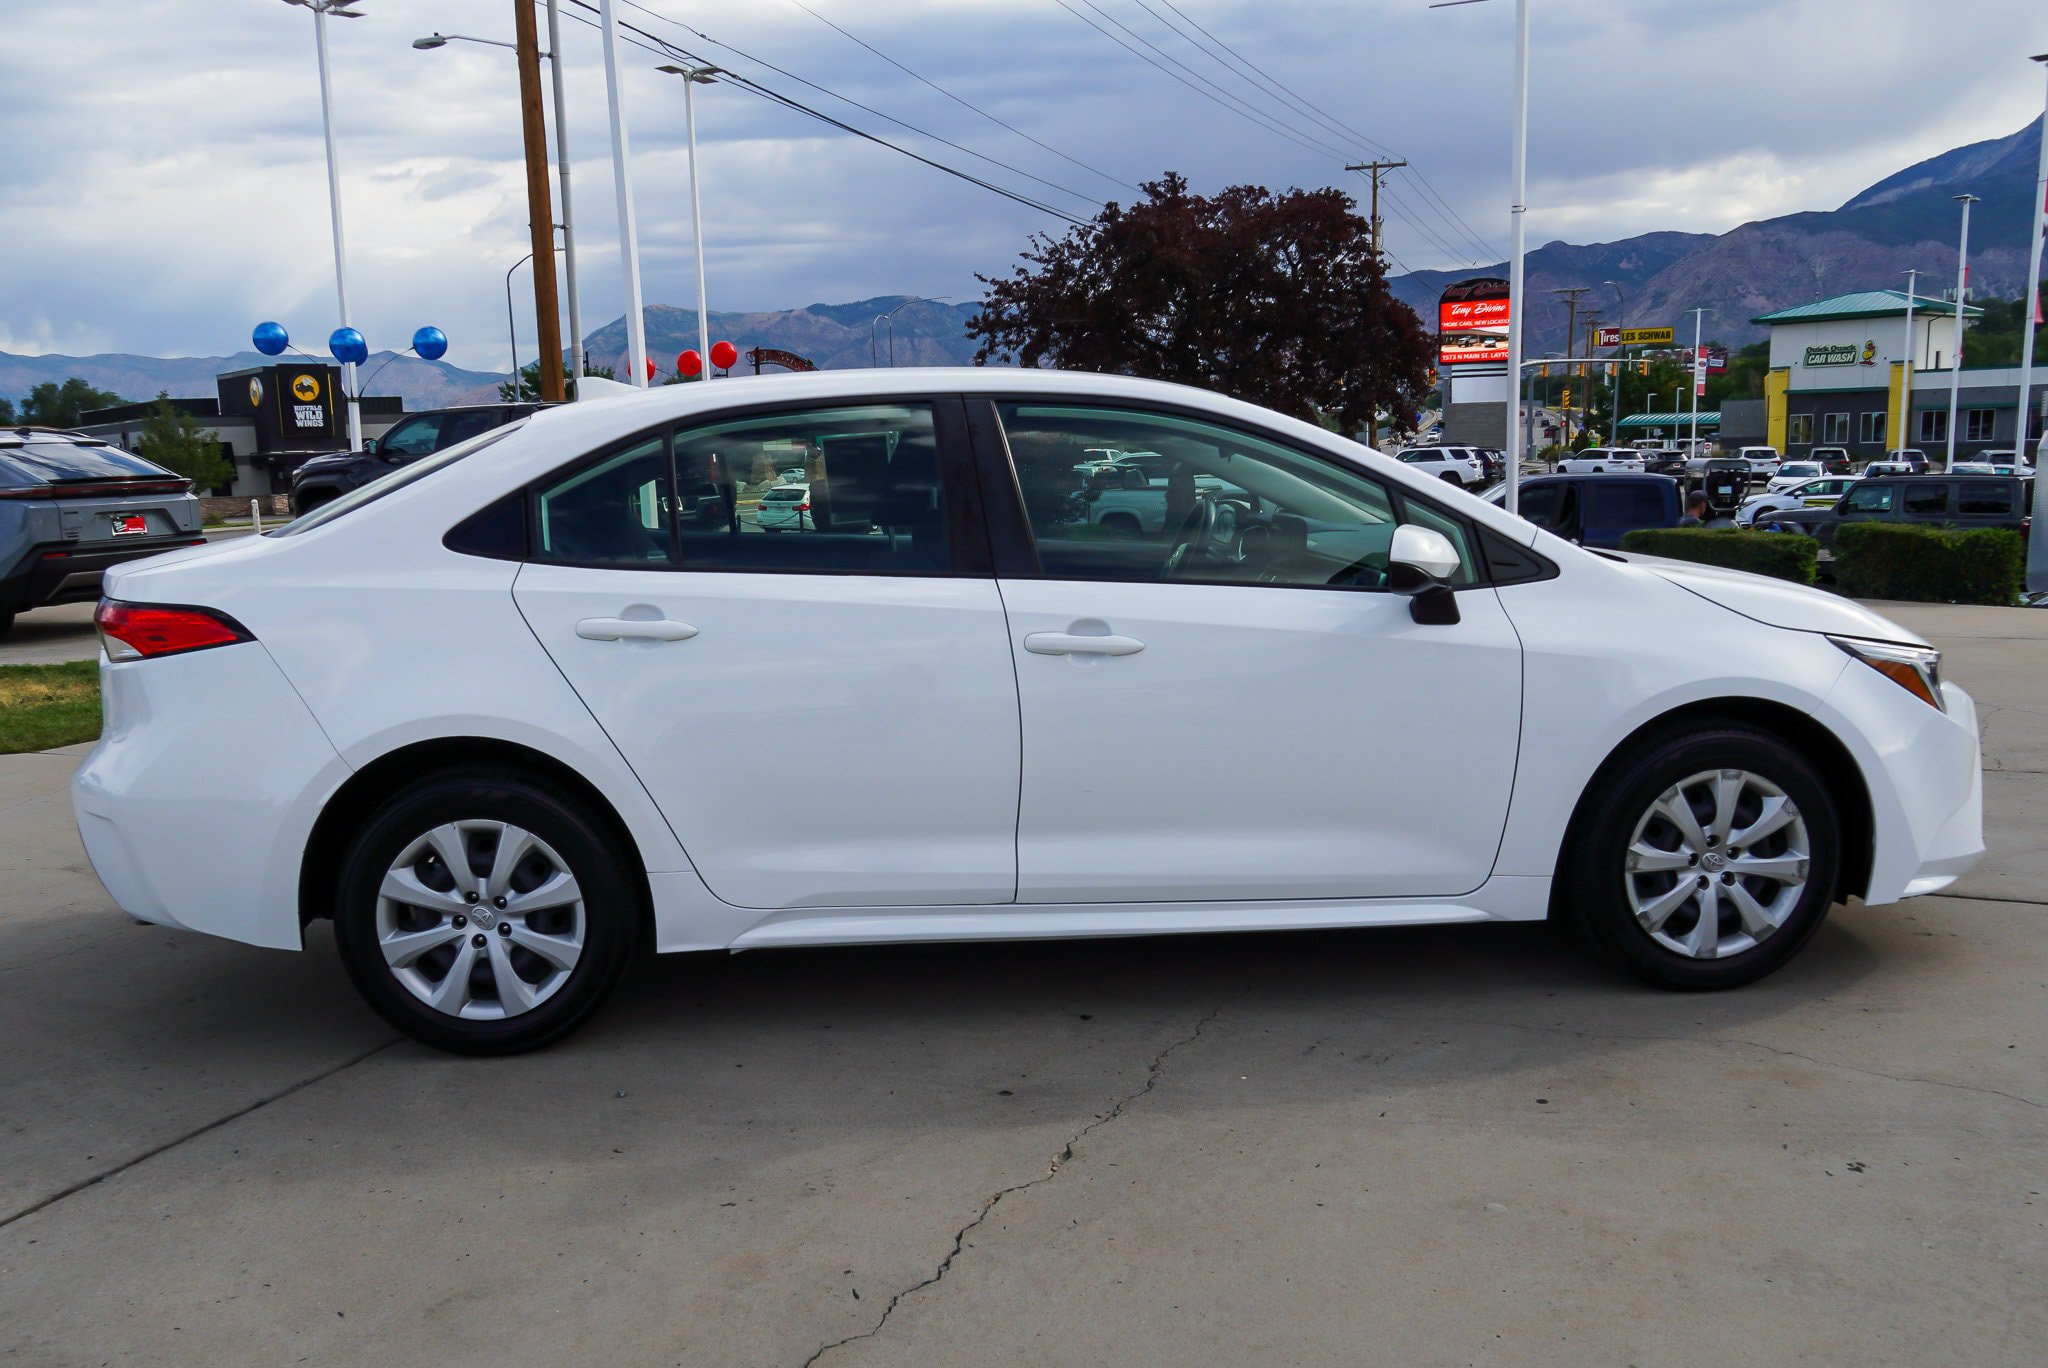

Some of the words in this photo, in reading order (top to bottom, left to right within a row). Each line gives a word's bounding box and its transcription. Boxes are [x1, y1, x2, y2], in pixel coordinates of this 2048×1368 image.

[1474, 281, 1510, 295] Divin
[1452, 305, 1471, 316] Tony
[1474, 303, 1506, 314] Divine
[1599, 330, 1620, 346] Tires
[1622, 332, 1635, 341] LES
[1638, 331, 1671, 341] SCHWAB
[1808, 354, 1826, 364] CAR
[1827, 352, 1855, 362] WASH
[294, 411, 323, 420] WILD
[295, 419, 324, 427] WINGS
